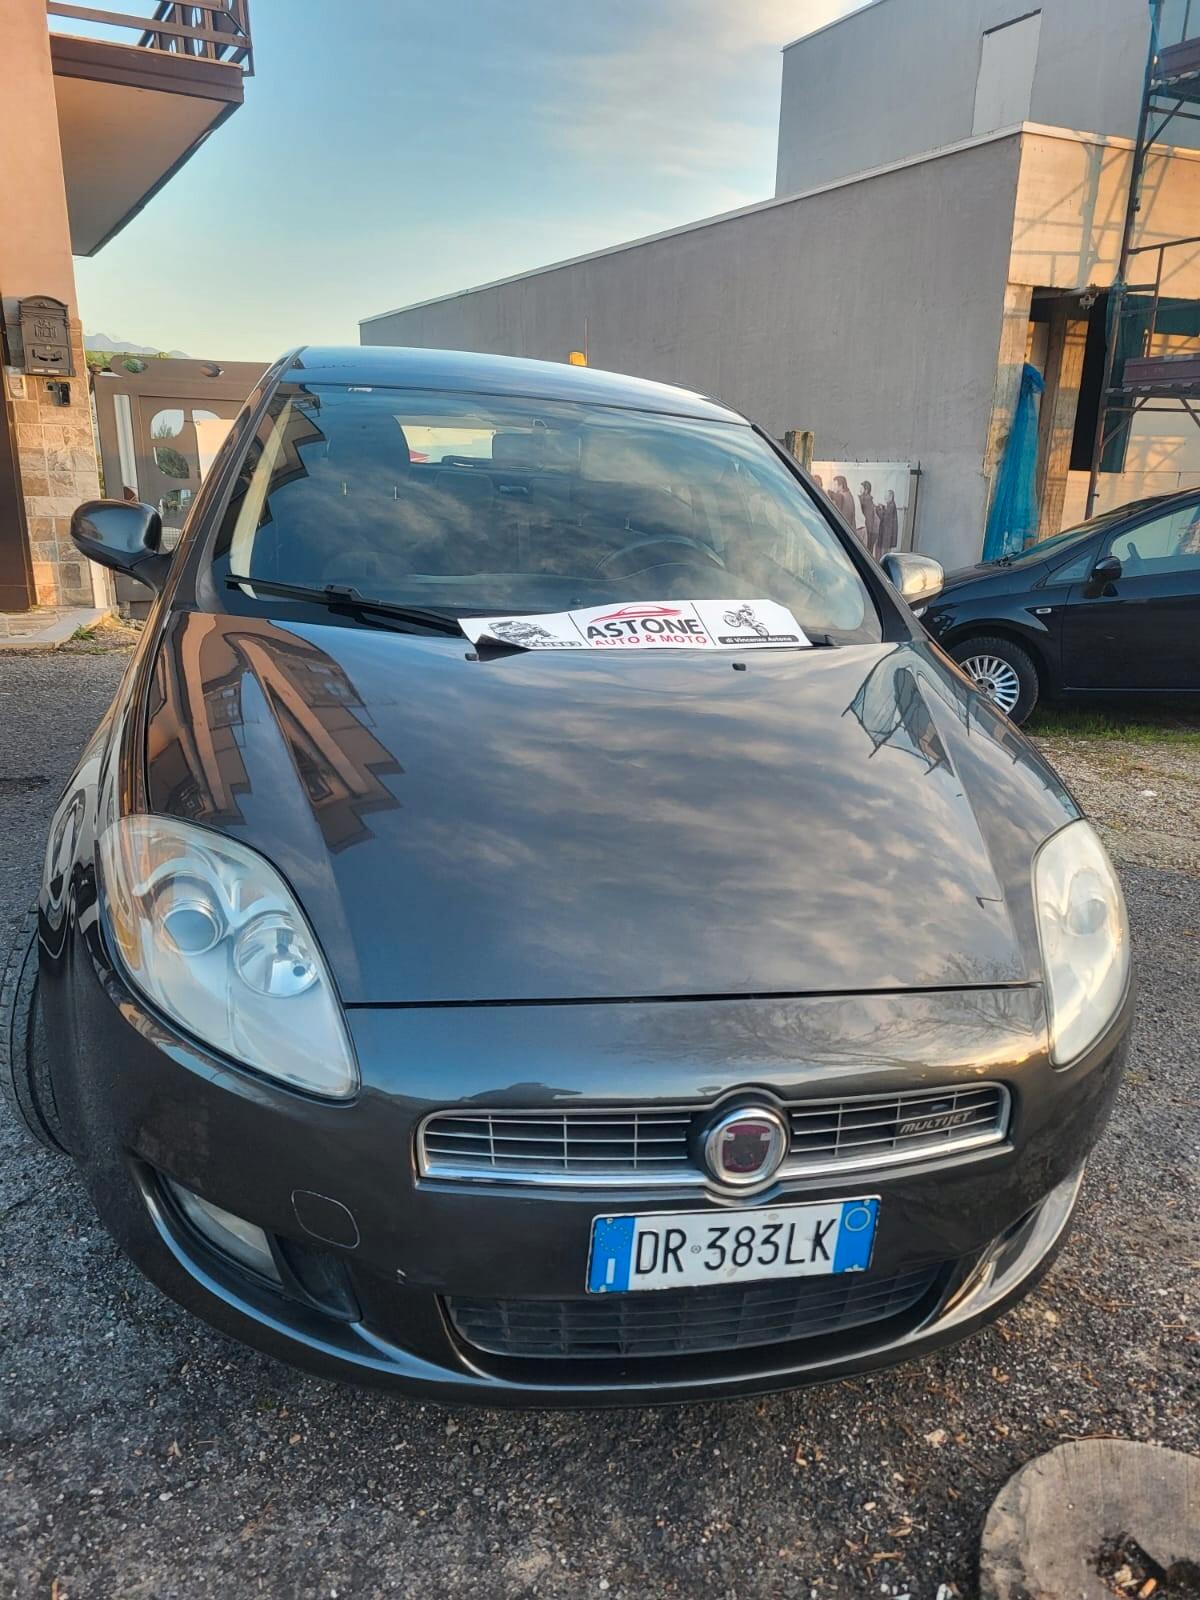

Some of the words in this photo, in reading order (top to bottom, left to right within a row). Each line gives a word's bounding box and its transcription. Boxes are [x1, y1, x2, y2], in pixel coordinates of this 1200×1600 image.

[587, 618, 704, 639] ASTONE
[594, 636, 640, 646] AUTO
[646, 634, 656, 643] &
[660, 634, 707, 644] MOTO
[899, 1111, 973, 1134] MULTIJET
[634, 1228, 687, 1275] DR
[704, 1218, 838, 1271] 383LK
